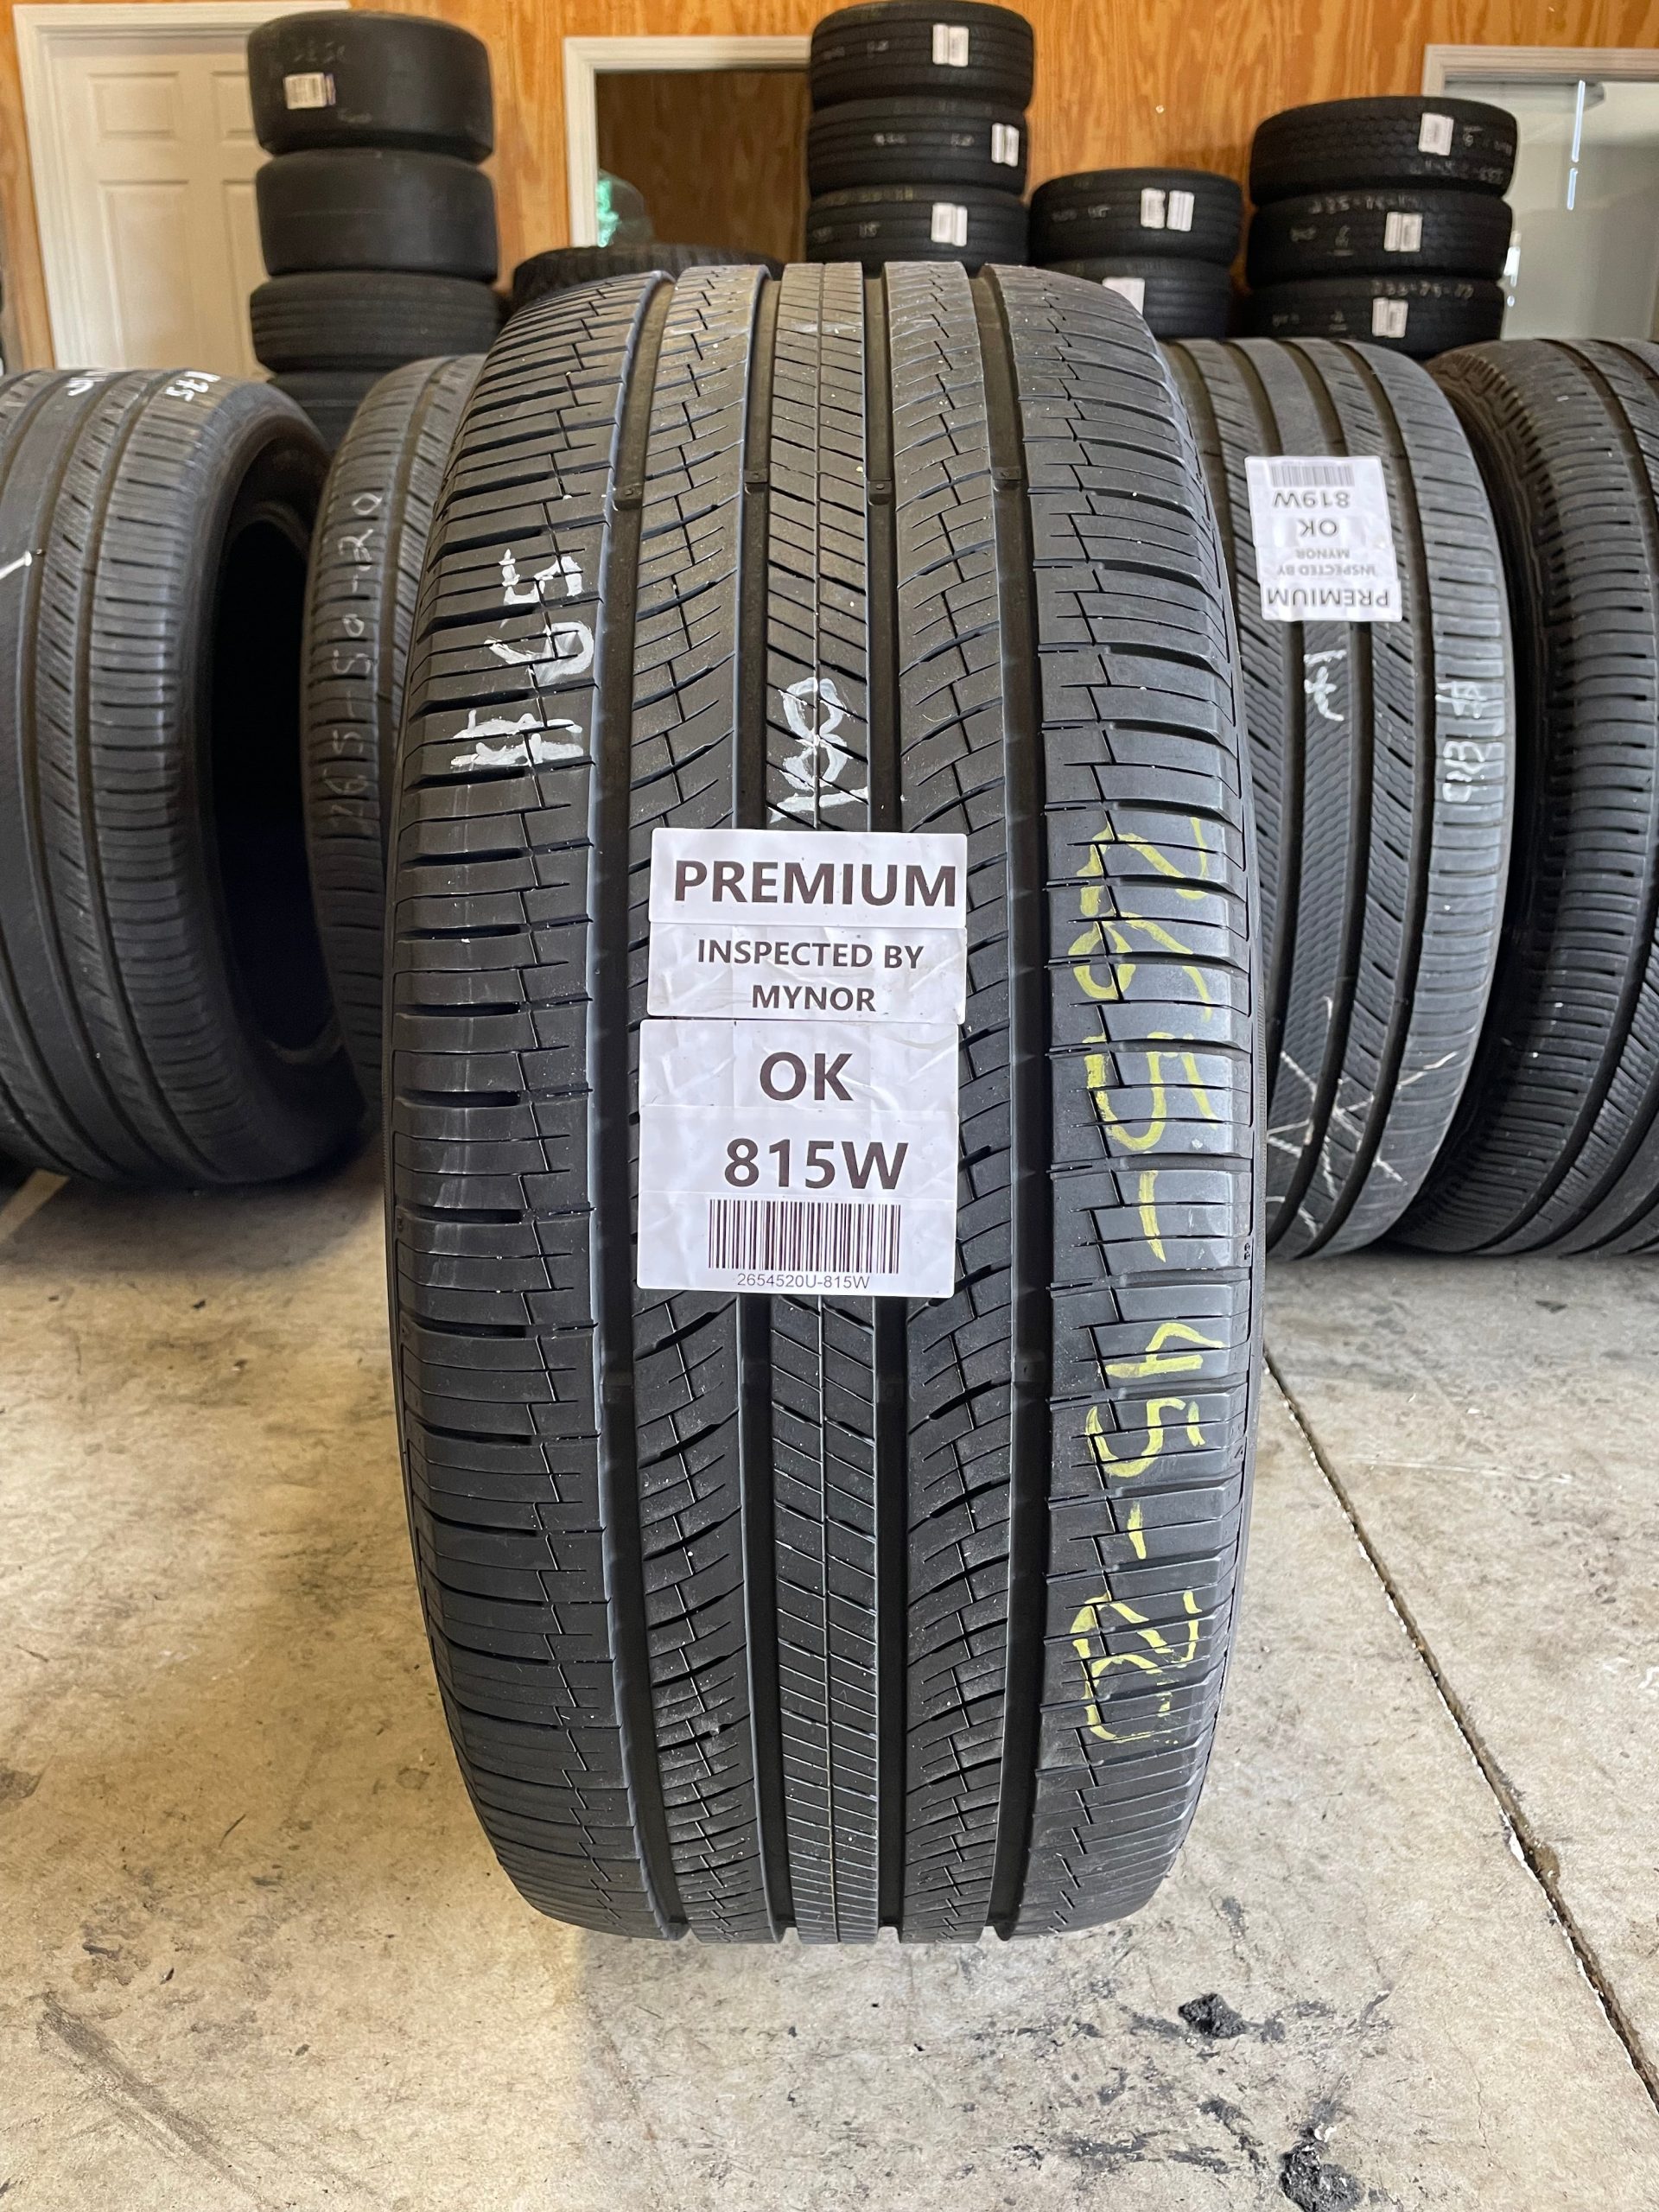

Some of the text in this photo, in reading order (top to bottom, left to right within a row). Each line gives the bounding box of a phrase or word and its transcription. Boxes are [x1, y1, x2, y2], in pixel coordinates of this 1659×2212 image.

[1273, 490, 1351, 509] 819W
[1300, 518, 1338, 537] OK
[1294, 548, 1351, 560] MYNOR
[1277, 563, 1376, 577] INSPECTED BY
[1267, 588, 1391, 607] PREMIUM
[674, 859, 957, 907] PREMIUM
[698, 938, 924, 969] INSPECTED BY
[752, 984, 876, 1012] MYNOR
[760, 1051, 854, 1102] OK
[724, 1137, 909, 1190] 815W
[736, 1273, 870, 1290] 2654520U-815W
